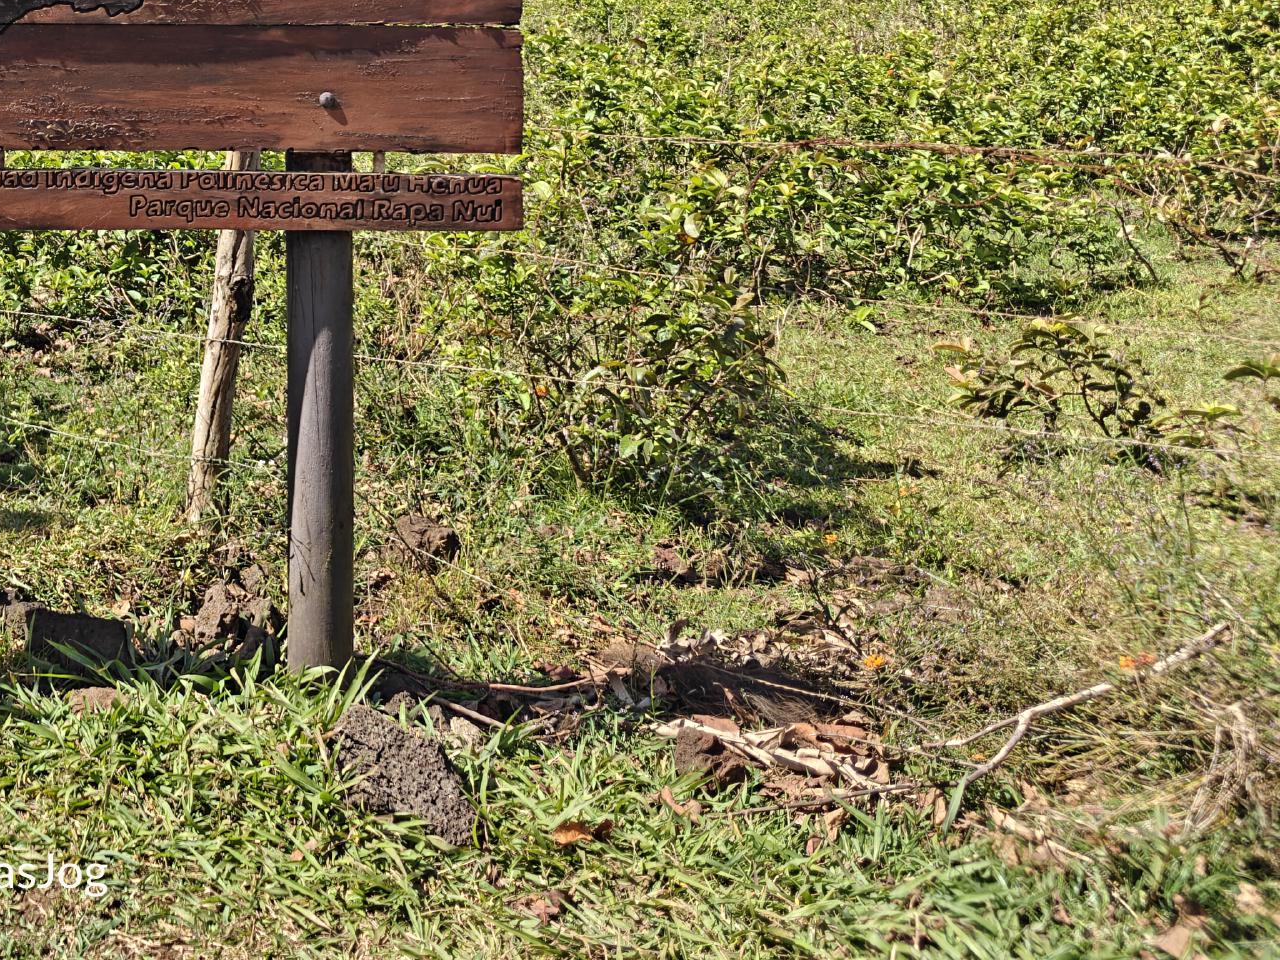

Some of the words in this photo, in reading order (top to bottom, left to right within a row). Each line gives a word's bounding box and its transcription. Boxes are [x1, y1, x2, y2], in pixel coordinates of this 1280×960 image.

[129, 194, 231, 224] Parque
[237, 195, 366, 221] Nacional
[372, 198, 445, 227] Rapa
[451, 198, 503, 223] Nui
